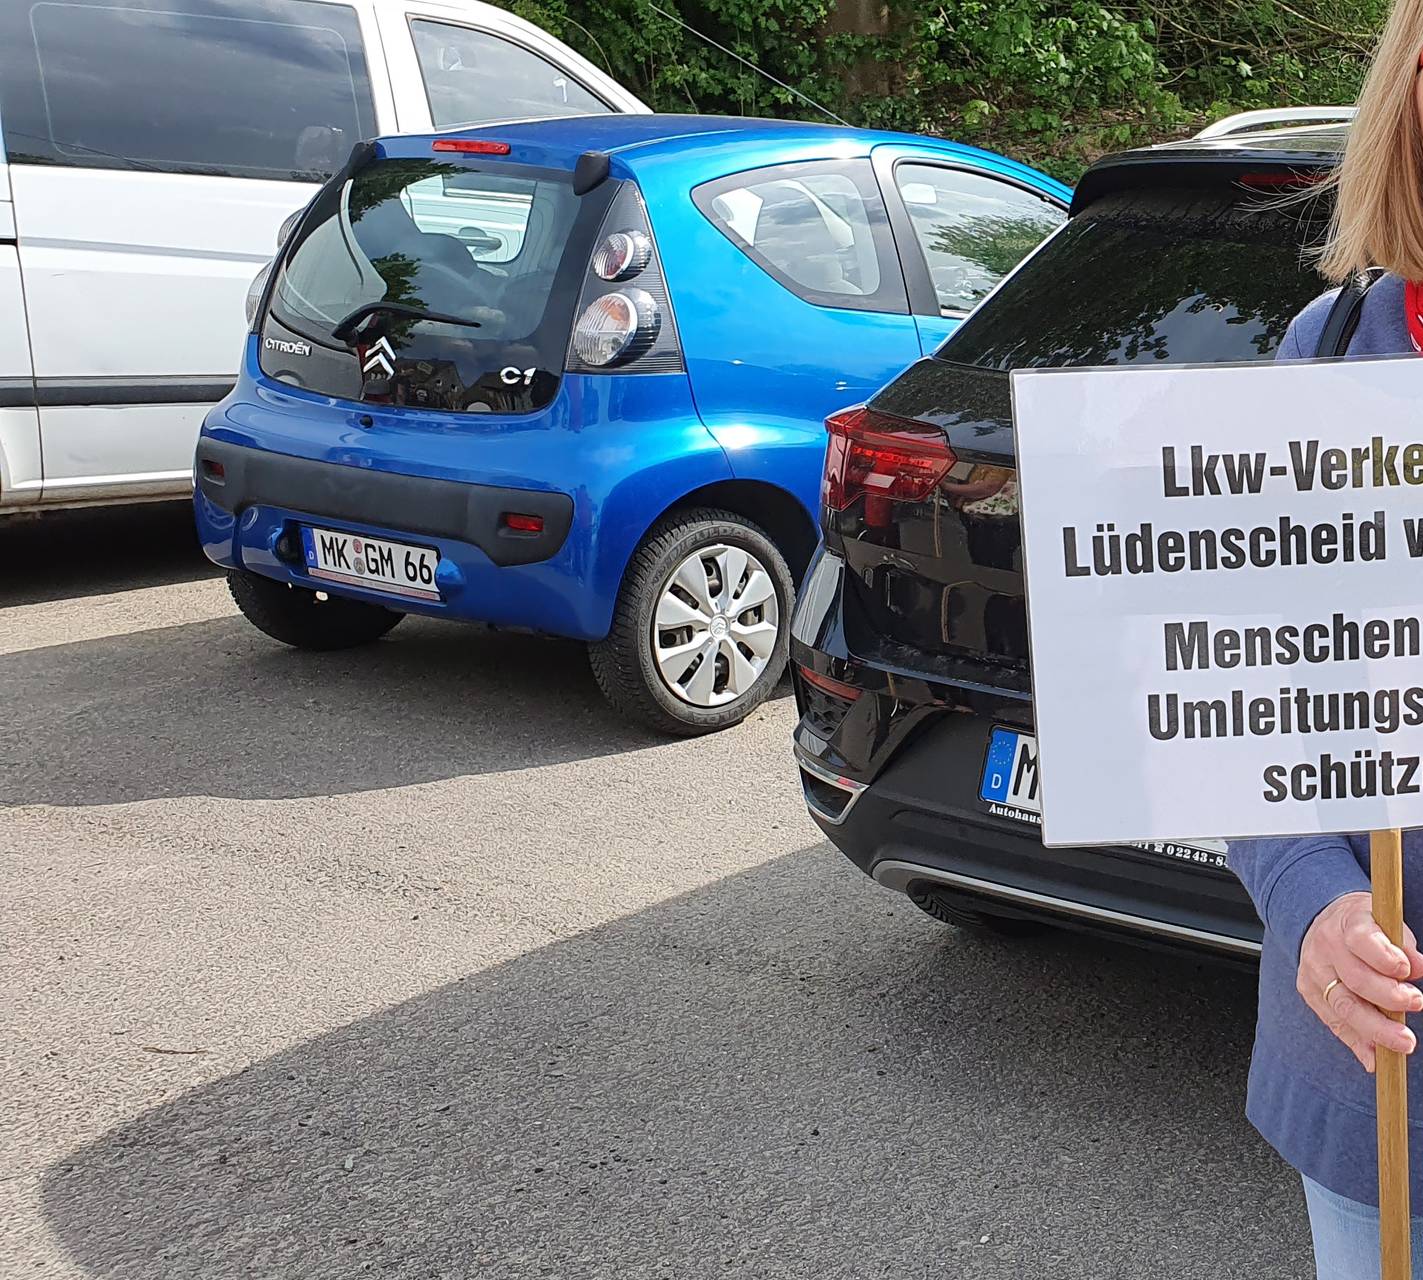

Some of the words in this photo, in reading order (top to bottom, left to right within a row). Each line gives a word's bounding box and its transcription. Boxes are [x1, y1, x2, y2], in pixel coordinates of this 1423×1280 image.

[265, 338, 311, 356] CITROËN
[500, 366, 537, 385] C1
[1063, 511, 1385, 577] Lüdenscheid
[308, 550, 315, 560] D
[320, 534, 351, 570] MK
[364, 542, 395, 579] GM
[404, 551, 432, 585] 66
[1165, 613, 1419, 671] Menschen
[991, 773, 1002, 789] D
[989, 803, 1042, 824] Autohaus
